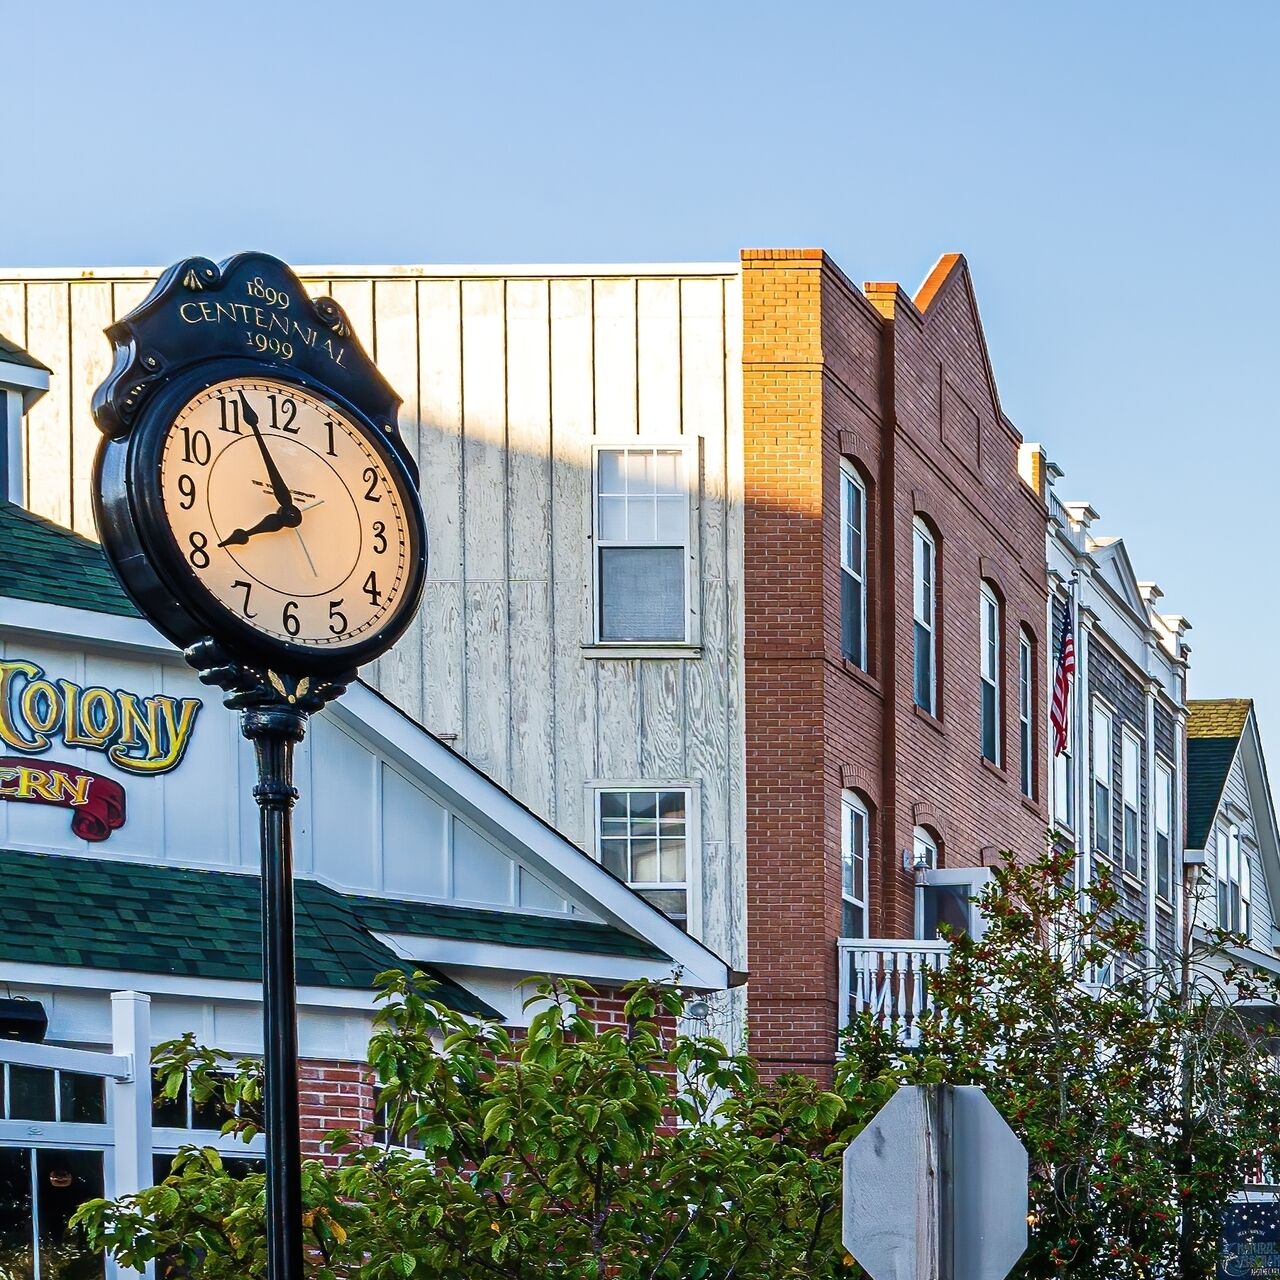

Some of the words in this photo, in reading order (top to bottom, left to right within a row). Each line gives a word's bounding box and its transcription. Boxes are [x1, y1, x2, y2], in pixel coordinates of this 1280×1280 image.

[246, 277, 290, 309] 1899
[179, 302, 347, 369] CENTENNIAL
[246, 331, 293, 360] 1999
[216, 396, 244, 435] 11
[267, 394, 300, 435] 12
[181, 427, 212, 467] 10
[324, 421, 339, 457] 1
[178, 474, 196, 510] 9
[362, 467, 382, 502] 2
[189, 531, 210, 569] 8
[372, 521, 388, 554] 3
[230, 580, 257, 618] 7
[362, 570, 382, 607] 4
[282, 601, 300, 637] 6
[329, 598, 348, 635] 5
